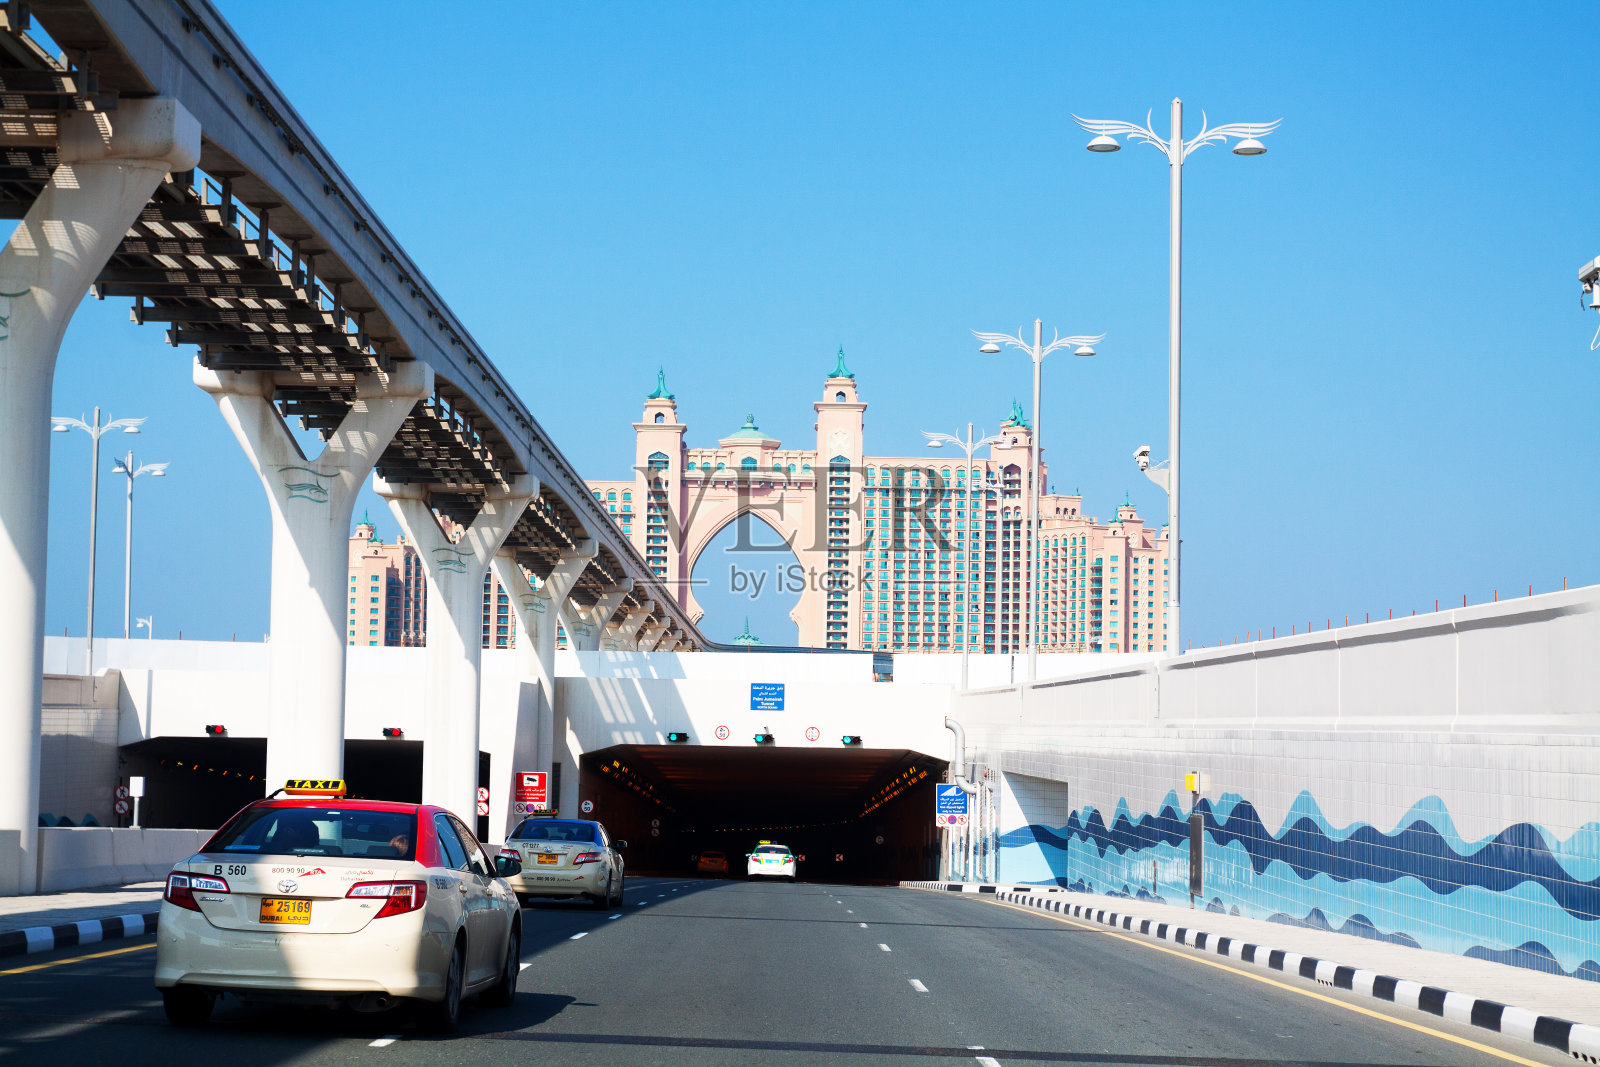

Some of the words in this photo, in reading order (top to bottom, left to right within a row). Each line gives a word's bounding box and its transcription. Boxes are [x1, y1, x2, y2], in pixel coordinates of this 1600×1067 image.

[214, 865, 222, 875] B
[228, 865, 247, 875] 560
[277, 900, 310, 912] 25169
